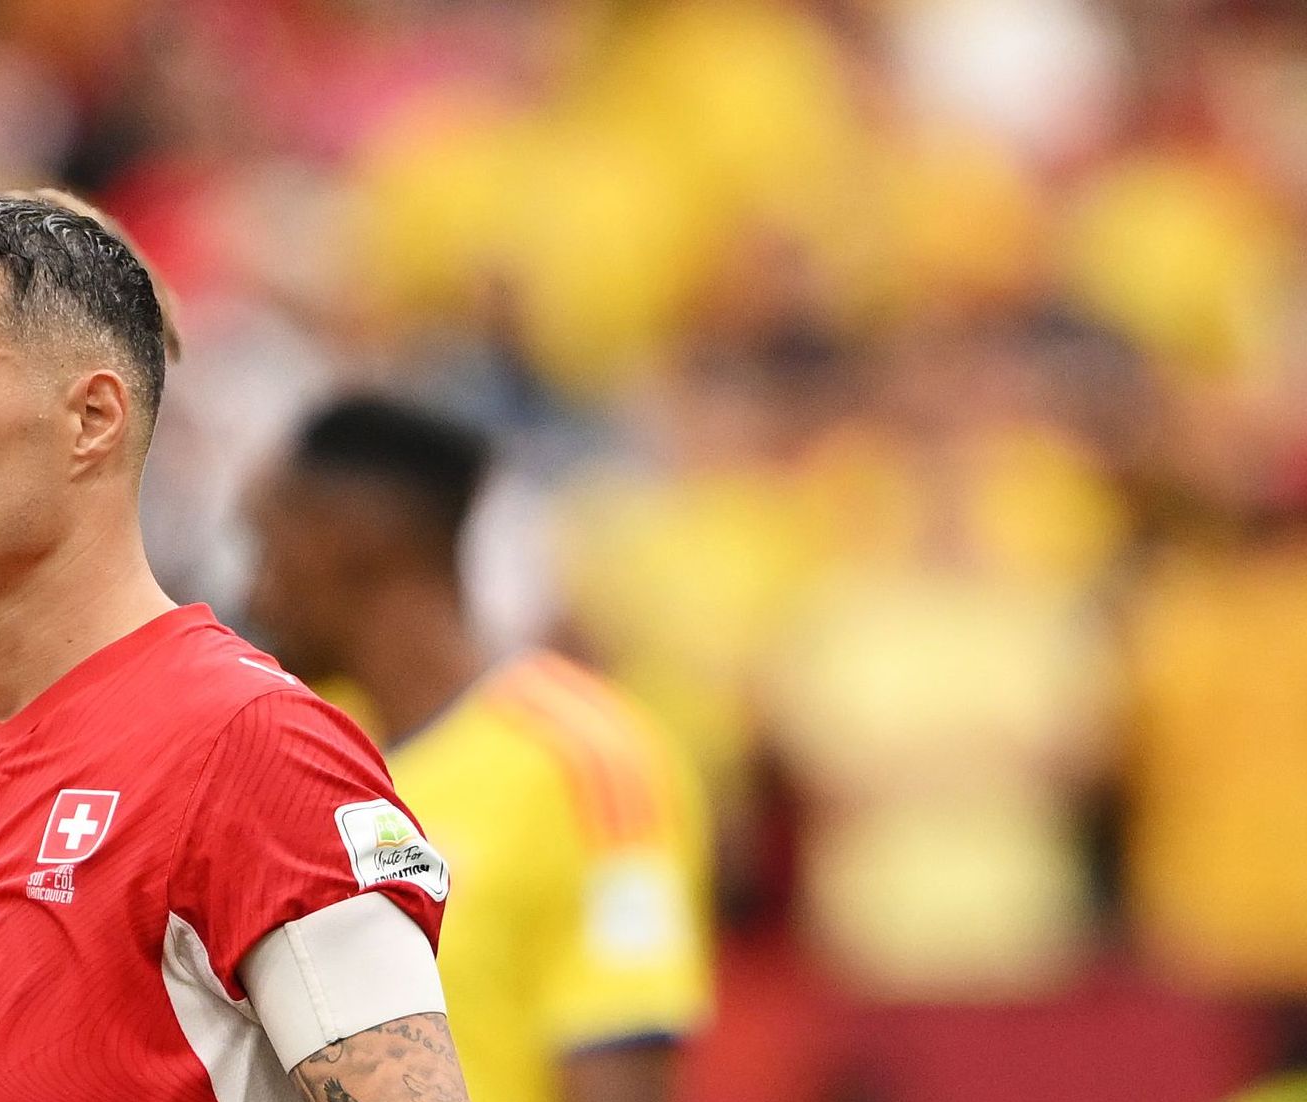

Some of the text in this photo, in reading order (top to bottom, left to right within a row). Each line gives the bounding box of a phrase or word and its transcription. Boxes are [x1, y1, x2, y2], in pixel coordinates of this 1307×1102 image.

[373, 845, 423, 871] Unite For
[54, 873, 75, 891] COL
[25, 886, 74, 904] VANCOUVER
